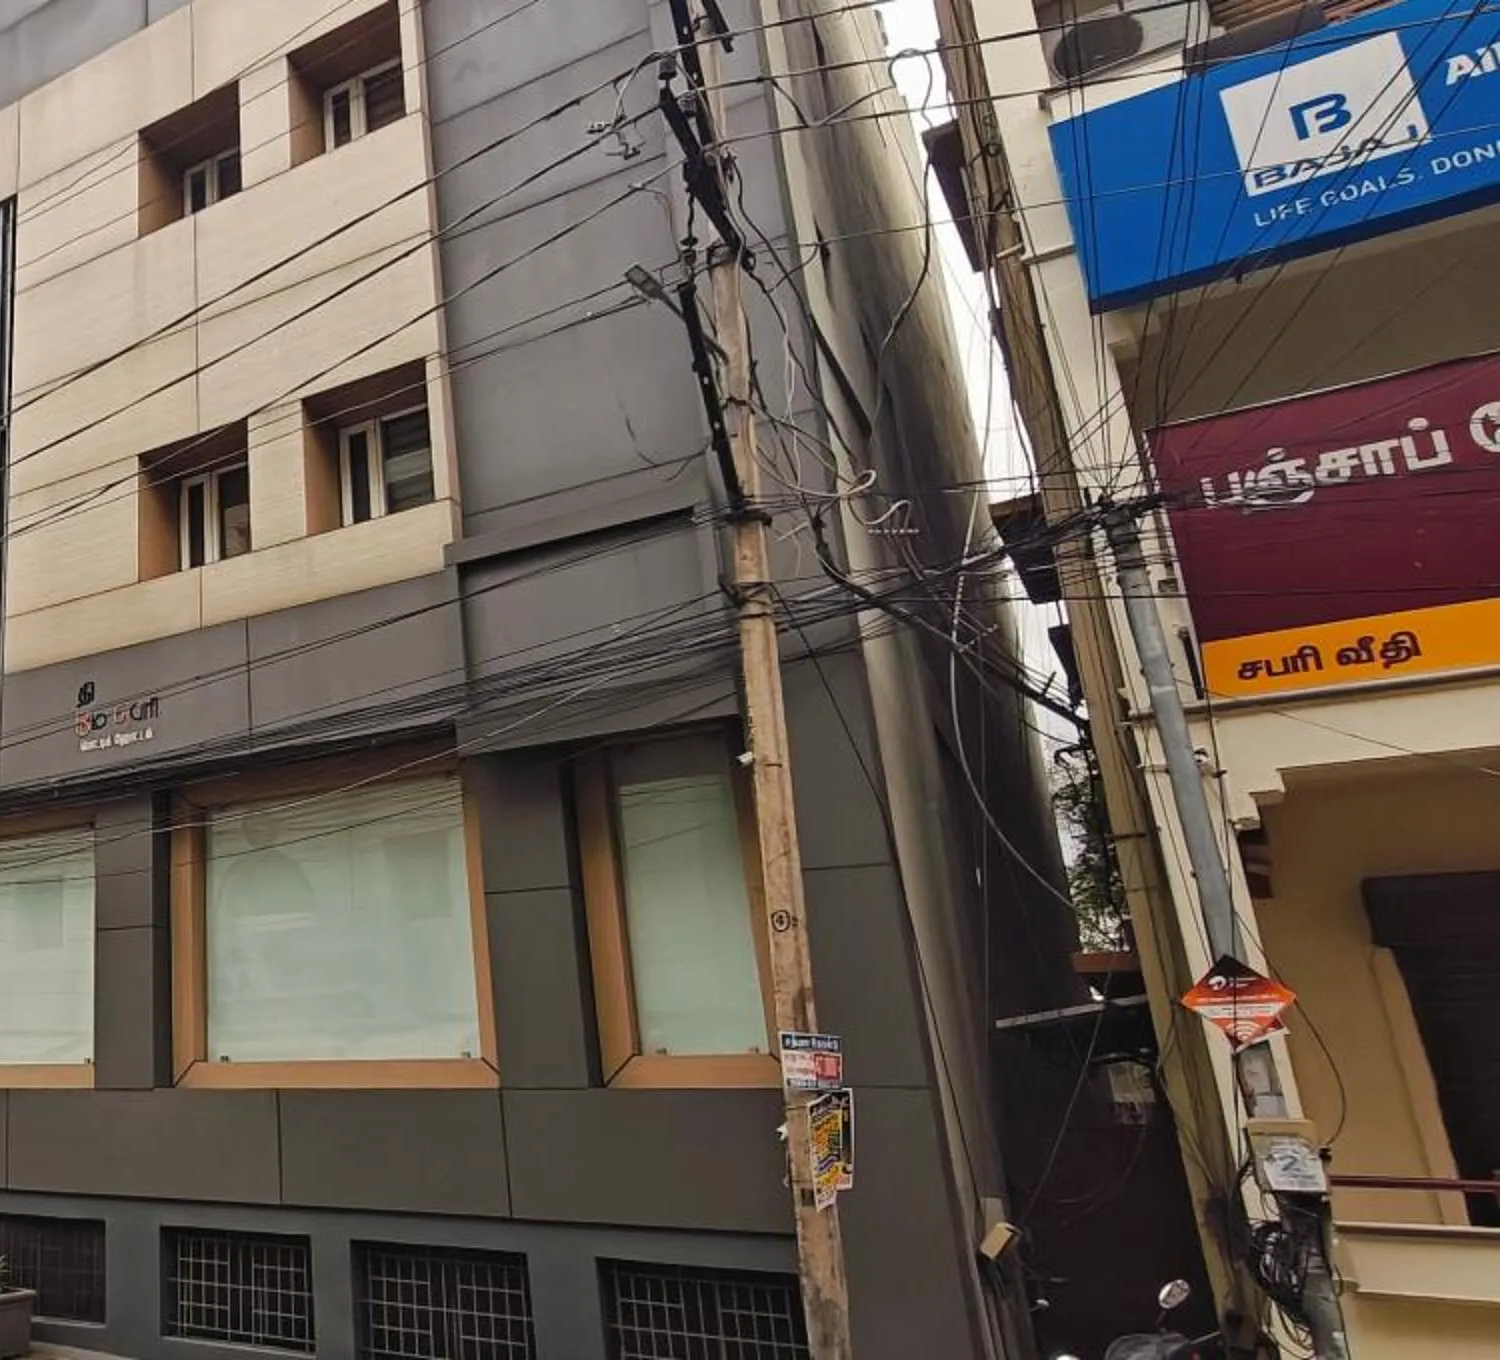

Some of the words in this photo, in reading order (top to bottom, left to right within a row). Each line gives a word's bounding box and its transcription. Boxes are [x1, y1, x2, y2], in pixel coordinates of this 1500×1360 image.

[1253, 124, 1420, 189] BAJAJ
[1253, 197, 1312, 227] LIFE
[1430, 140, 1500, 175] DON
[1237, 645, 1323, 680] சபரி
[1336, 631, 1422, 669] வீதி
